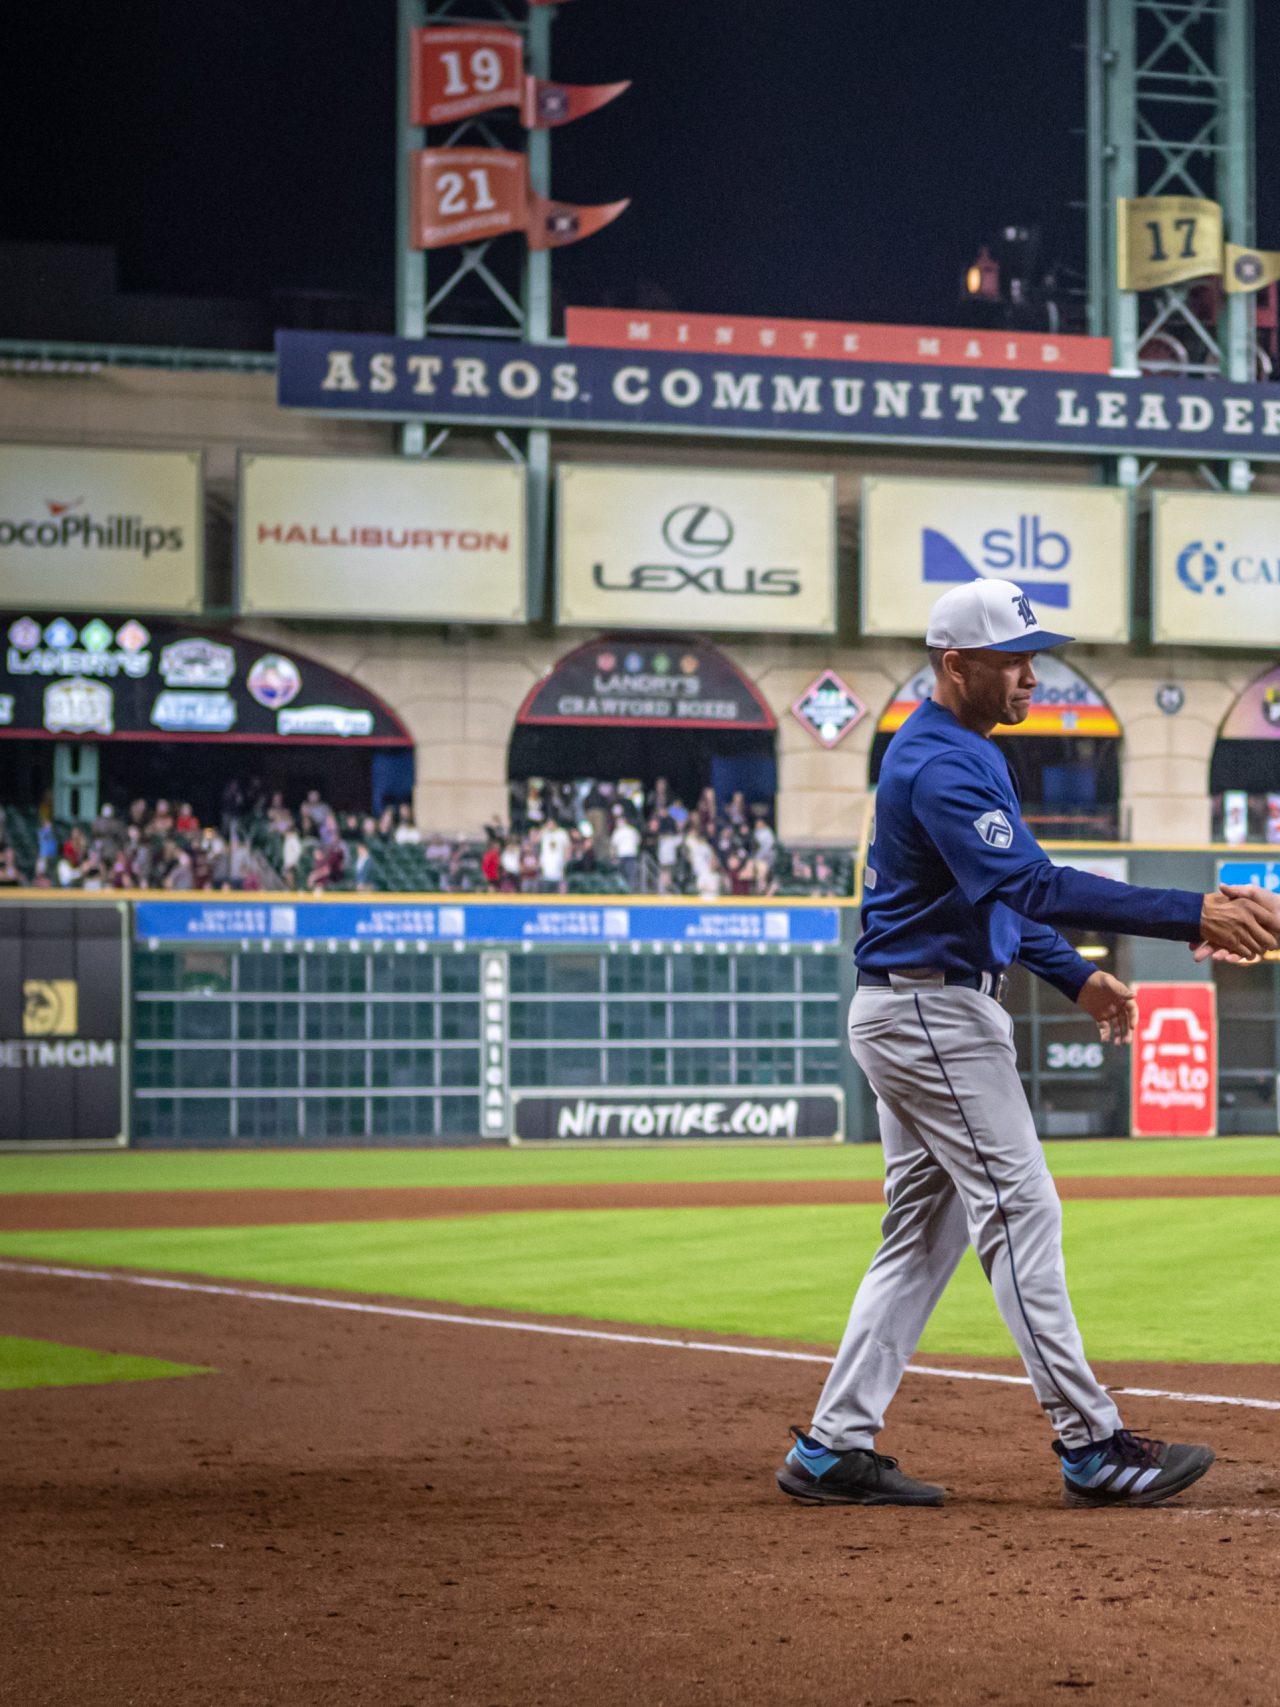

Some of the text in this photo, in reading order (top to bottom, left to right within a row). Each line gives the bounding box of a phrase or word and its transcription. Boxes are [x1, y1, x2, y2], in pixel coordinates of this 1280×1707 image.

[440, 48, 502, 96] 19
[436, 169, 496, 215] 21
[1145, 218, 1197, 261] 17
[628, 321, 1060, 362] MINUTE MAID
[613, 367, 1028, 425] COMMUNITY
[257, 523, 509, 552] HALLIBURTON
[982, 515, 1071, 571] slb
[593, 563, 802, 596] LEXUS
[1046, 1042, 1104, 1069] 366
[1141, 1063, 1209, 1090] Auto
[558, 1100, 798, 1138] NITTOTIRE.COM
